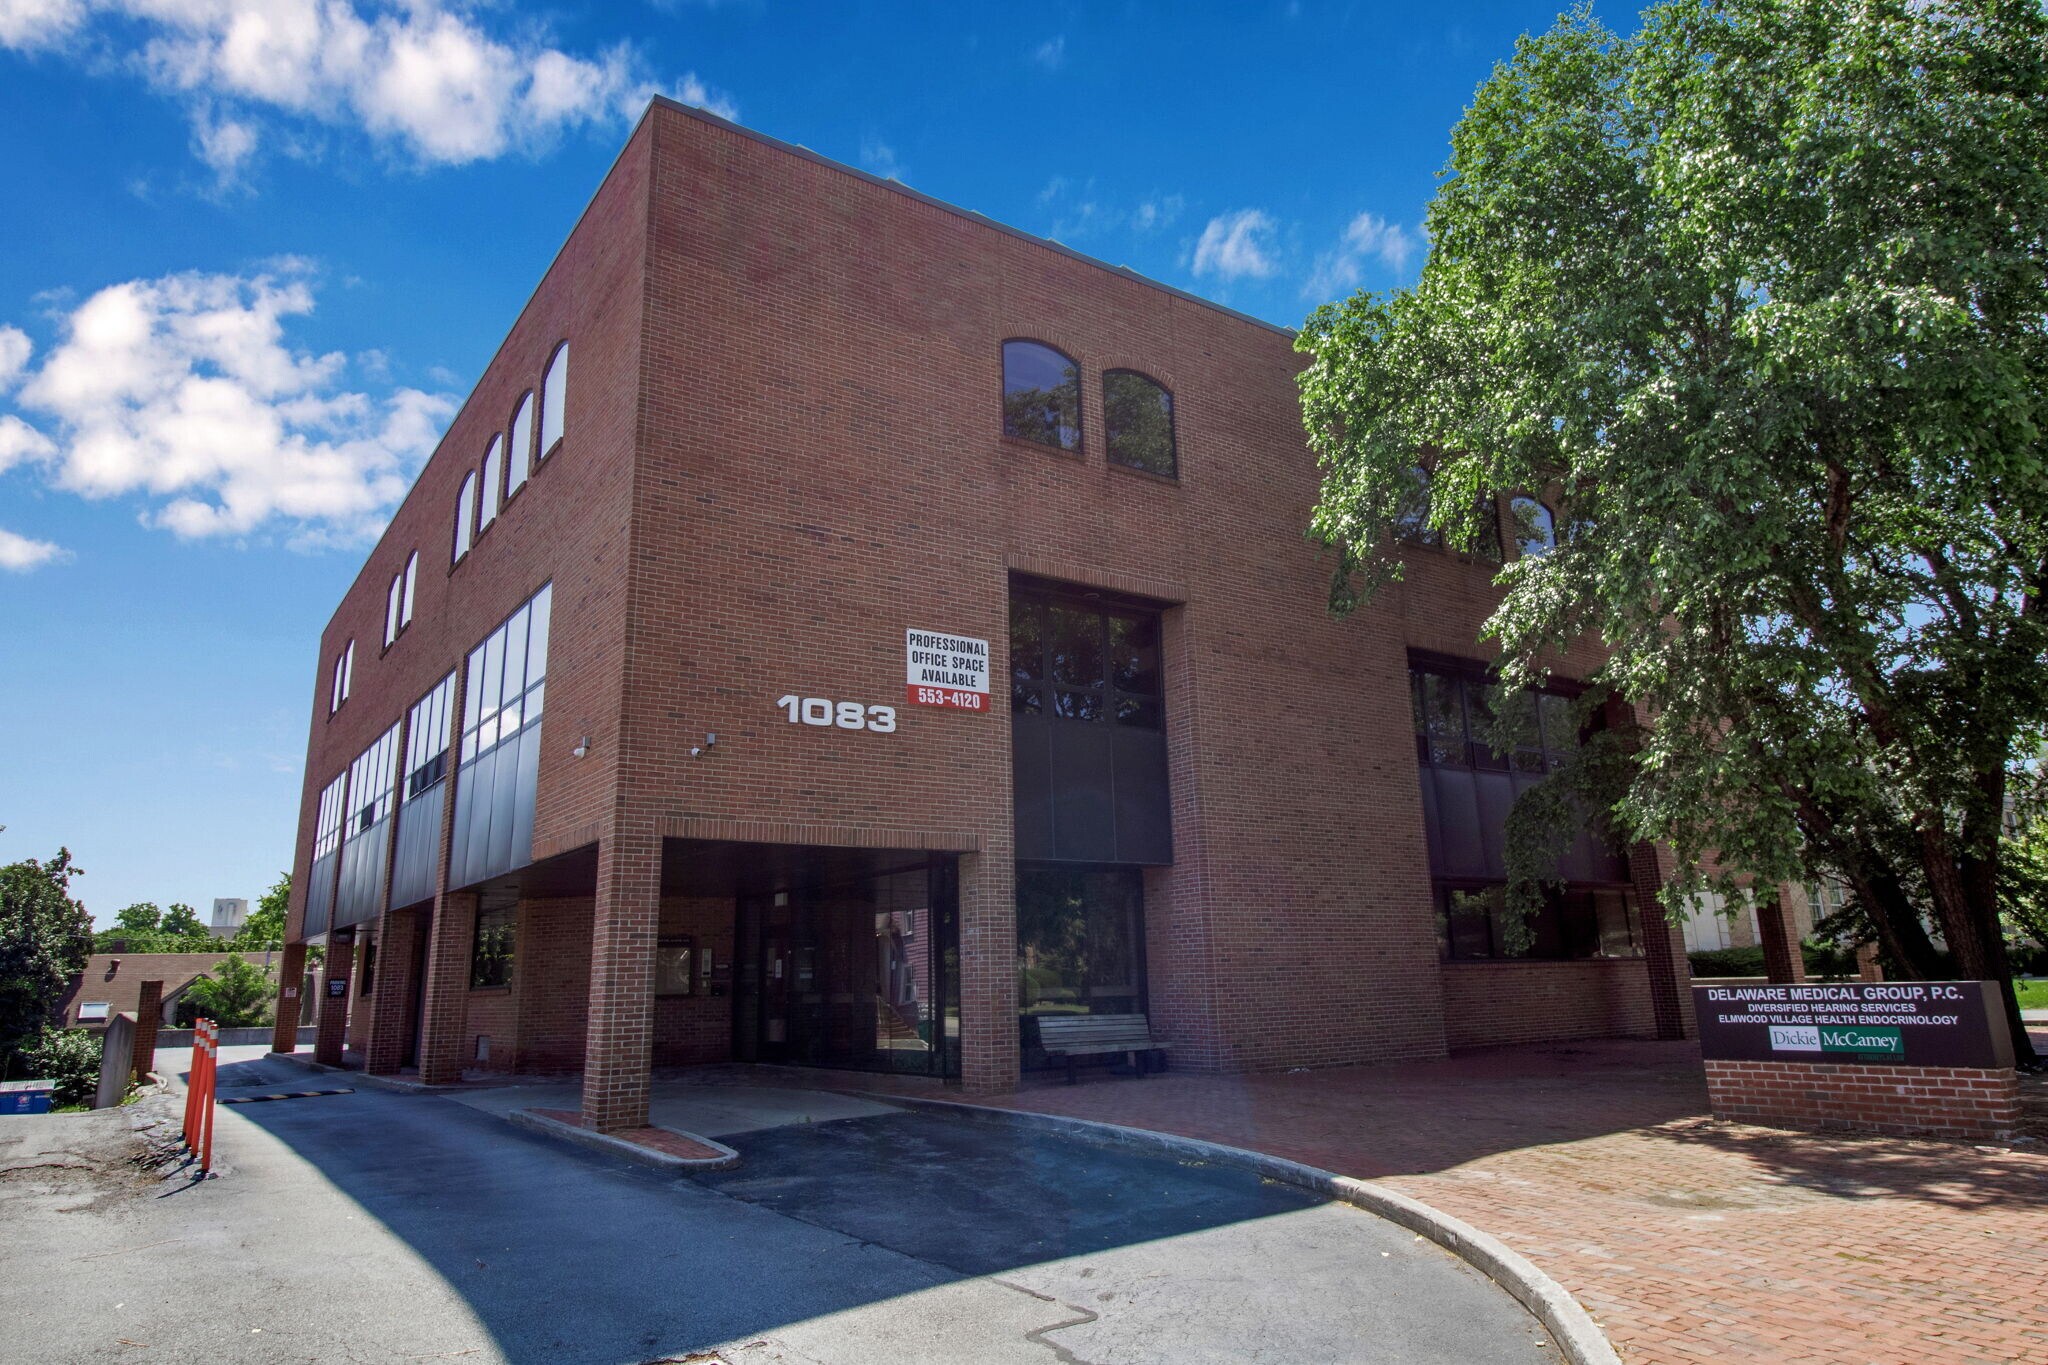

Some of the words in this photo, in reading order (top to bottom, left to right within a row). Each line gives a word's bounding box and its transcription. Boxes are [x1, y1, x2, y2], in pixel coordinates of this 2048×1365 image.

[909, 633, 986, 656] PROFESSIONAL
[912, 650, 947, 668] OFFICE
[952, 656, 984, 673] SPACE
[921, 668, 976, 687] AVAILABLE
[918, 687, 980, 709] 553-4120
[776, 694, 896, 733] 1083
[1708, 988, 1787, 1001] DELAWARE
[1790, 987, 1861, 1001] MEDICAL
[1863, 986, 1927, 1002] GROUP,
[1931, 986, 1964, 1000] P.C.
[1748, 1003, 1809, 1013] DIVERSIFIED
[1810, 1003, 1859, 1013] HEARING
[1861, 1003, 1917, 1013] SERVICES
[1718, 1014, 1768, 1024] ELMWOOD
[1769, 1014, 1813, 1024] VILLAGE
[1815, 1015, 1857, 1025] HEALTH
[1858, 1015, 1959, 1026] ENDOCRINOLOGY
[1773, 1031, 1817, 1046] Dickie
